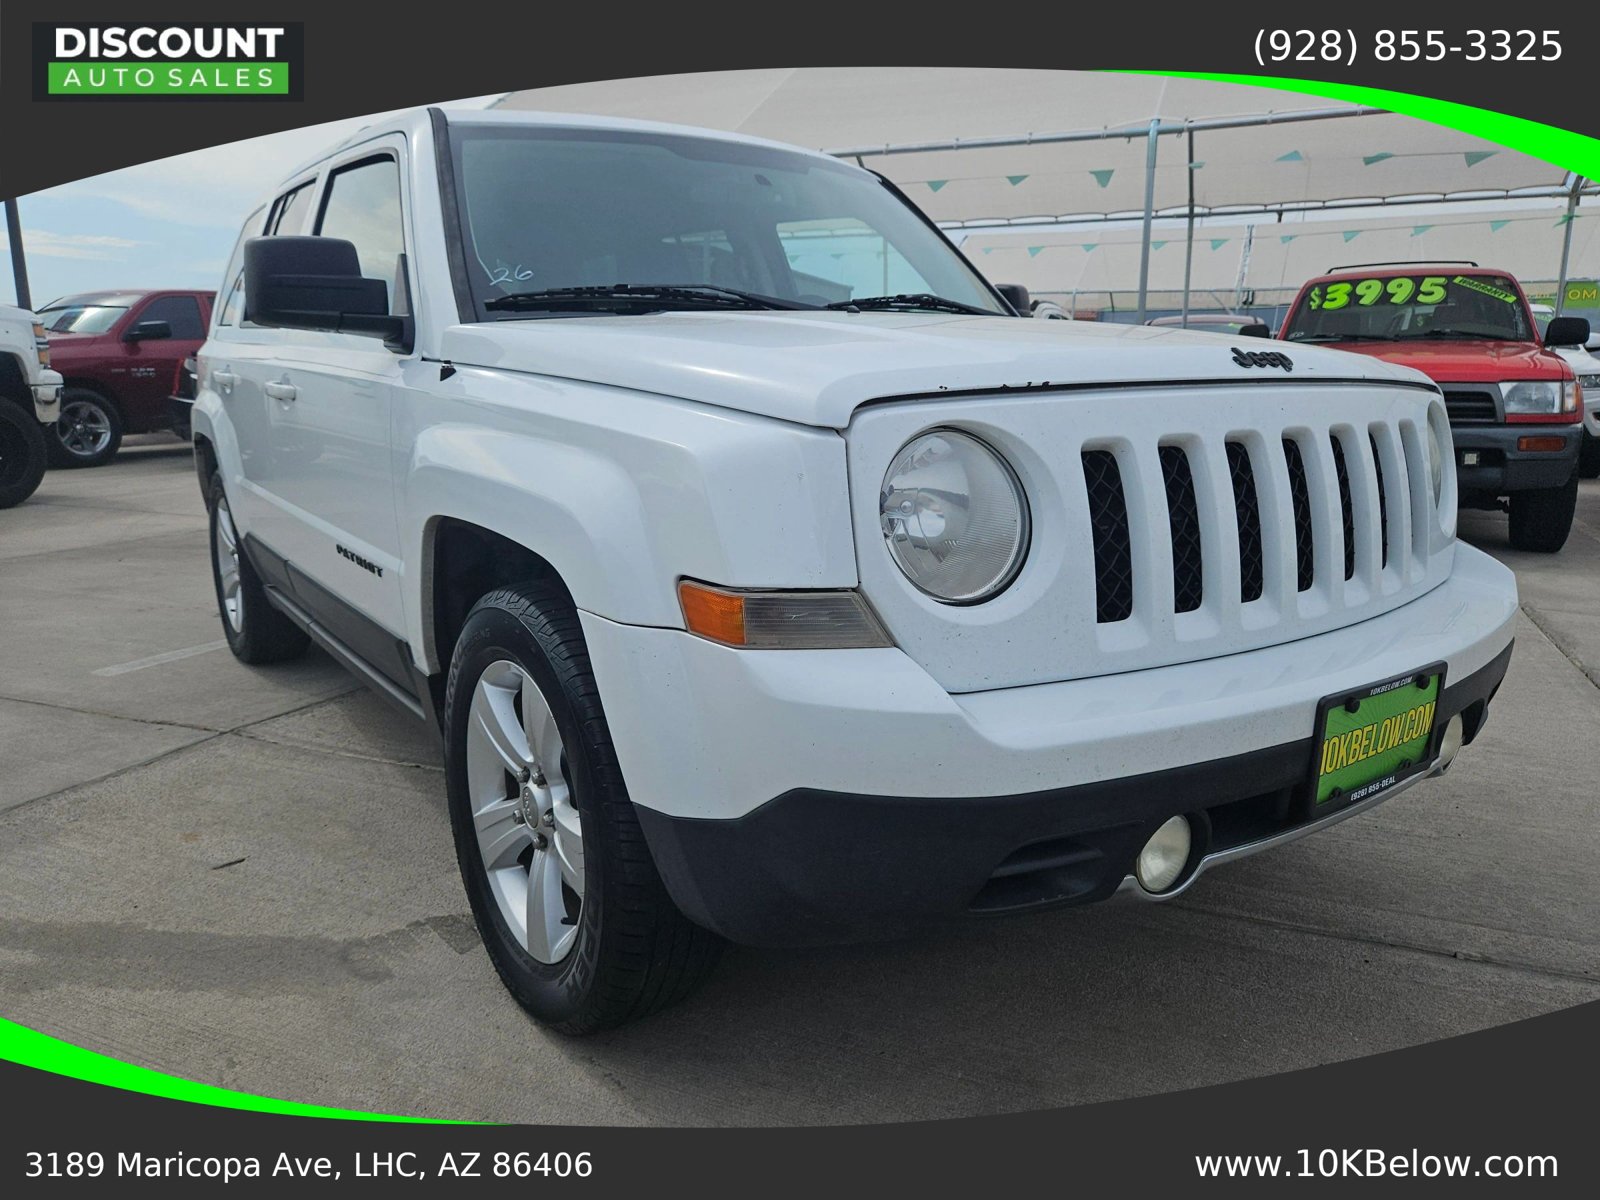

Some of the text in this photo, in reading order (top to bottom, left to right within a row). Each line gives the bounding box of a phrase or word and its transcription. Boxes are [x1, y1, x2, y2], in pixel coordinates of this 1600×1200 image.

[1309, 277, 1448, 311] $3995
[1458, 277, 1512, 299] WARRANTY
[1230, 347, 1294, 372] Jeep
[336, 543, 383, 578] PATRIOT
[1370, 676, 1413, 696] 10KBELOW.COM
[1320, 701, 1436, 776] 10KBELOW.COM
[1351, 775, 1396, 801] (928) 855-DEAL
